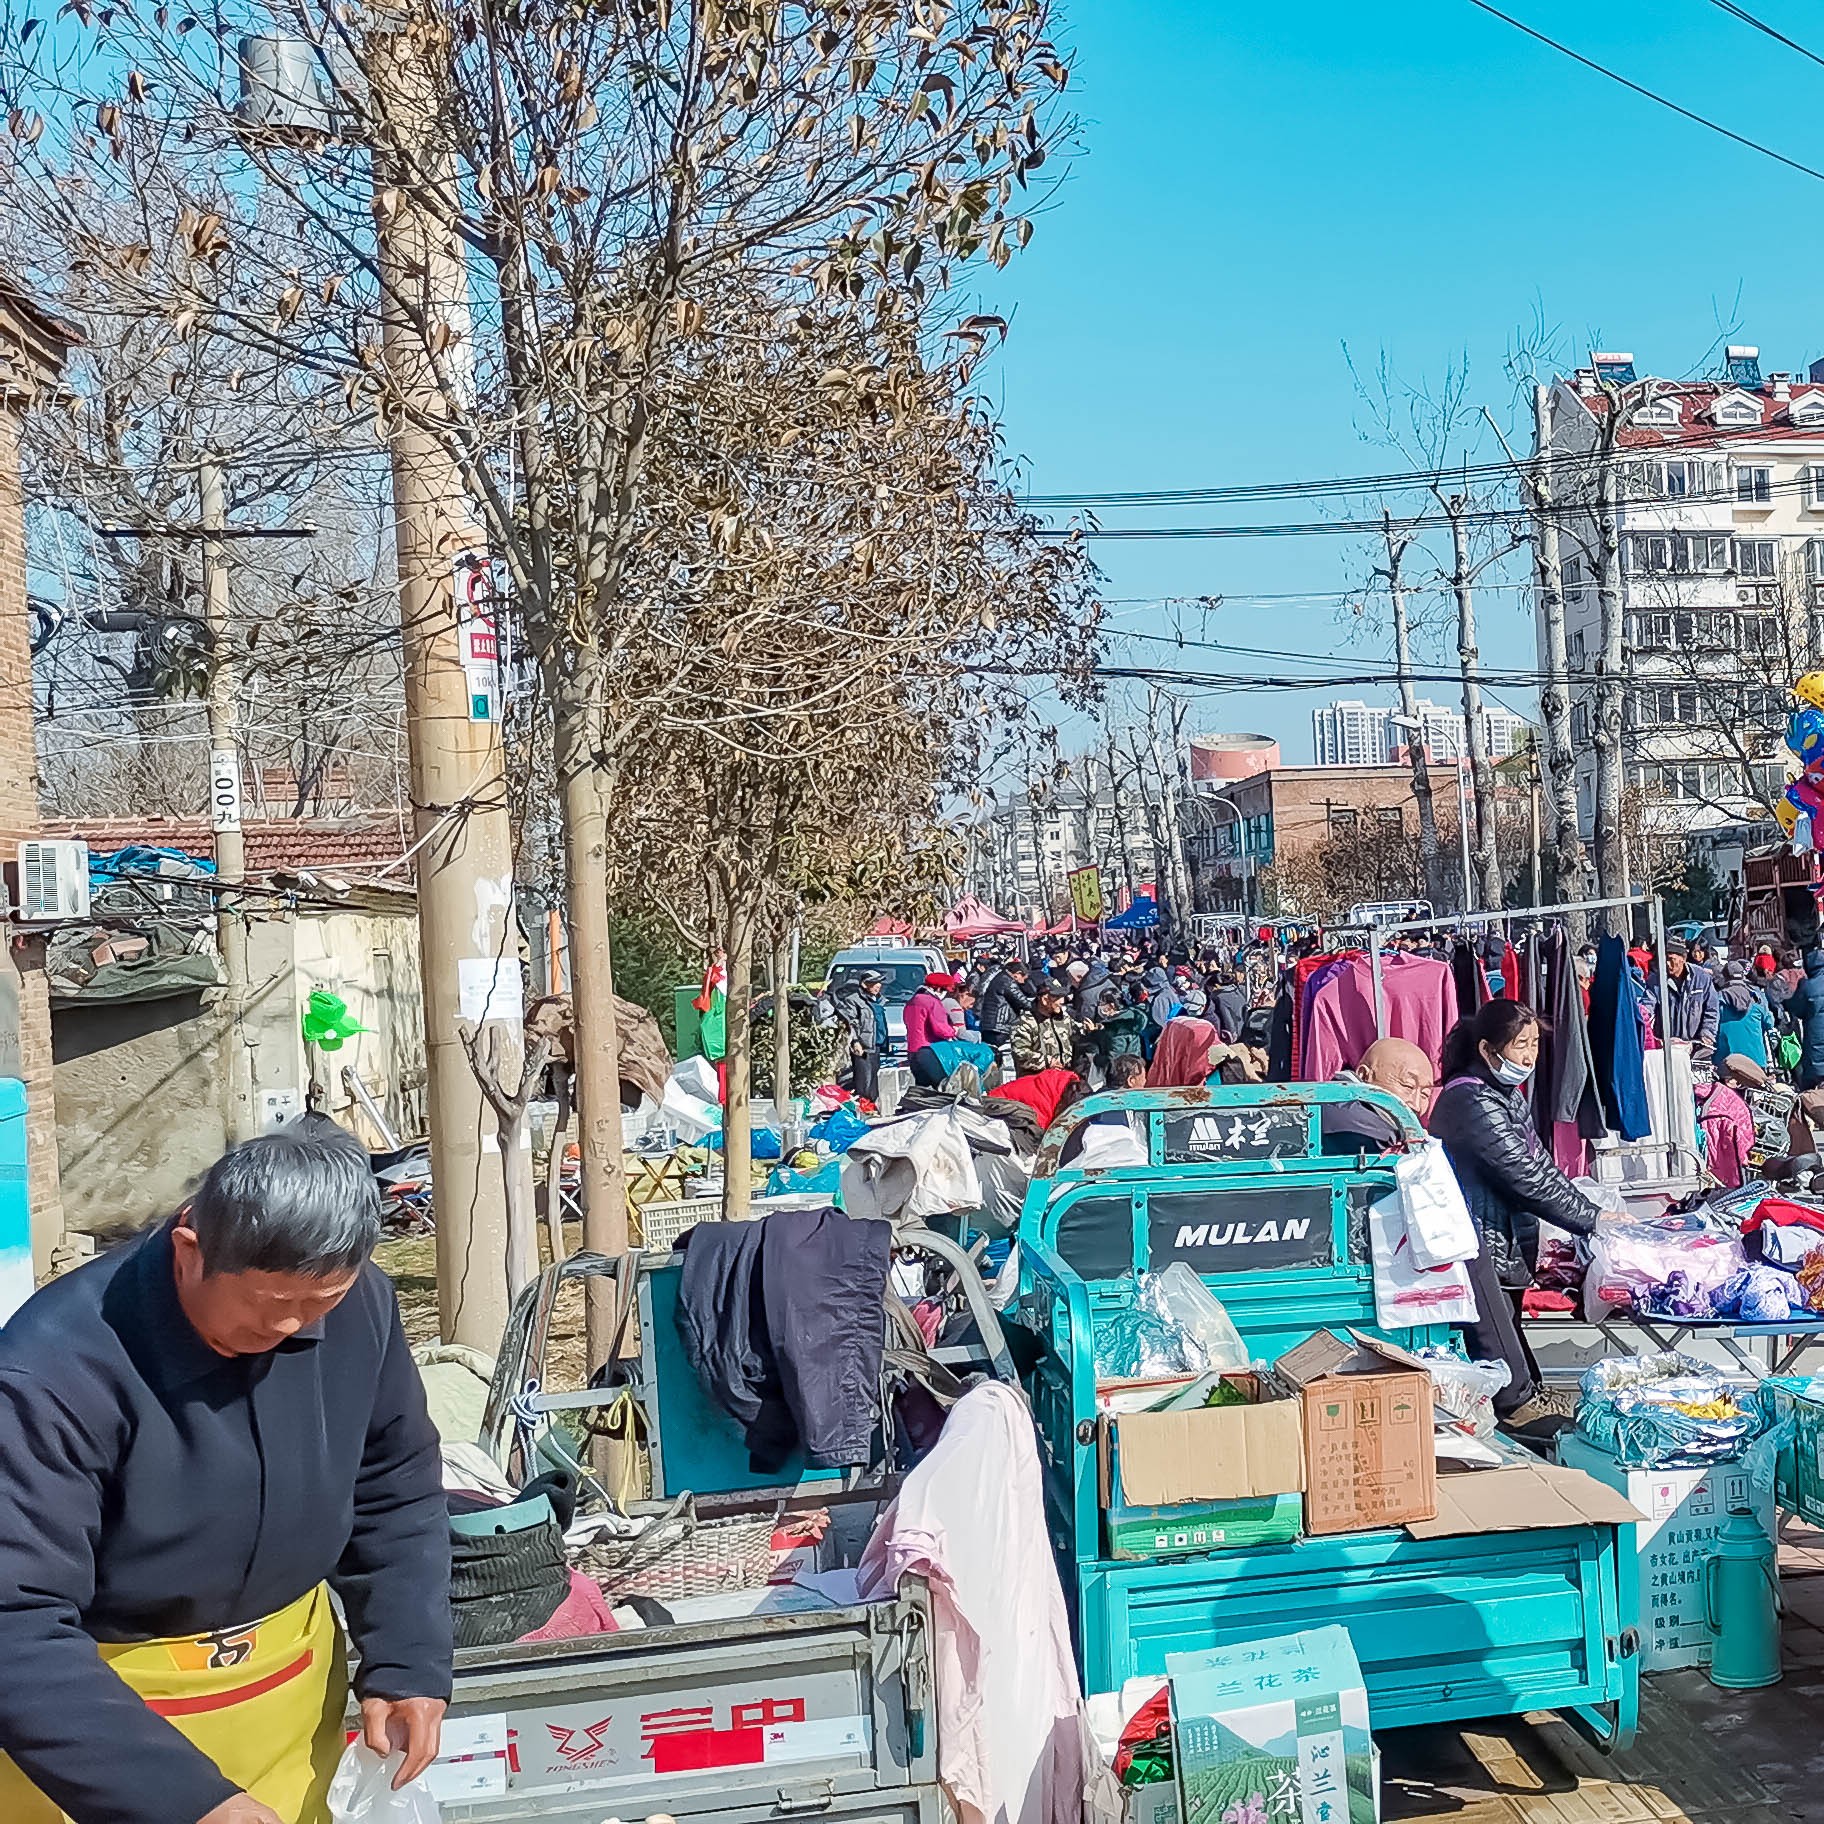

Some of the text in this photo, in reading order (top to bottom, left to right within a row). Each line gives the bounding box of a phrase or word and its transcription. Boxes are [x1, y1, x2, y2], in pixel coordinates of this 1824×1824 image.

[1174, 1218, 1311, 1248] MULAN
[1216, 1665, 1321, 1697] 兰花茶
